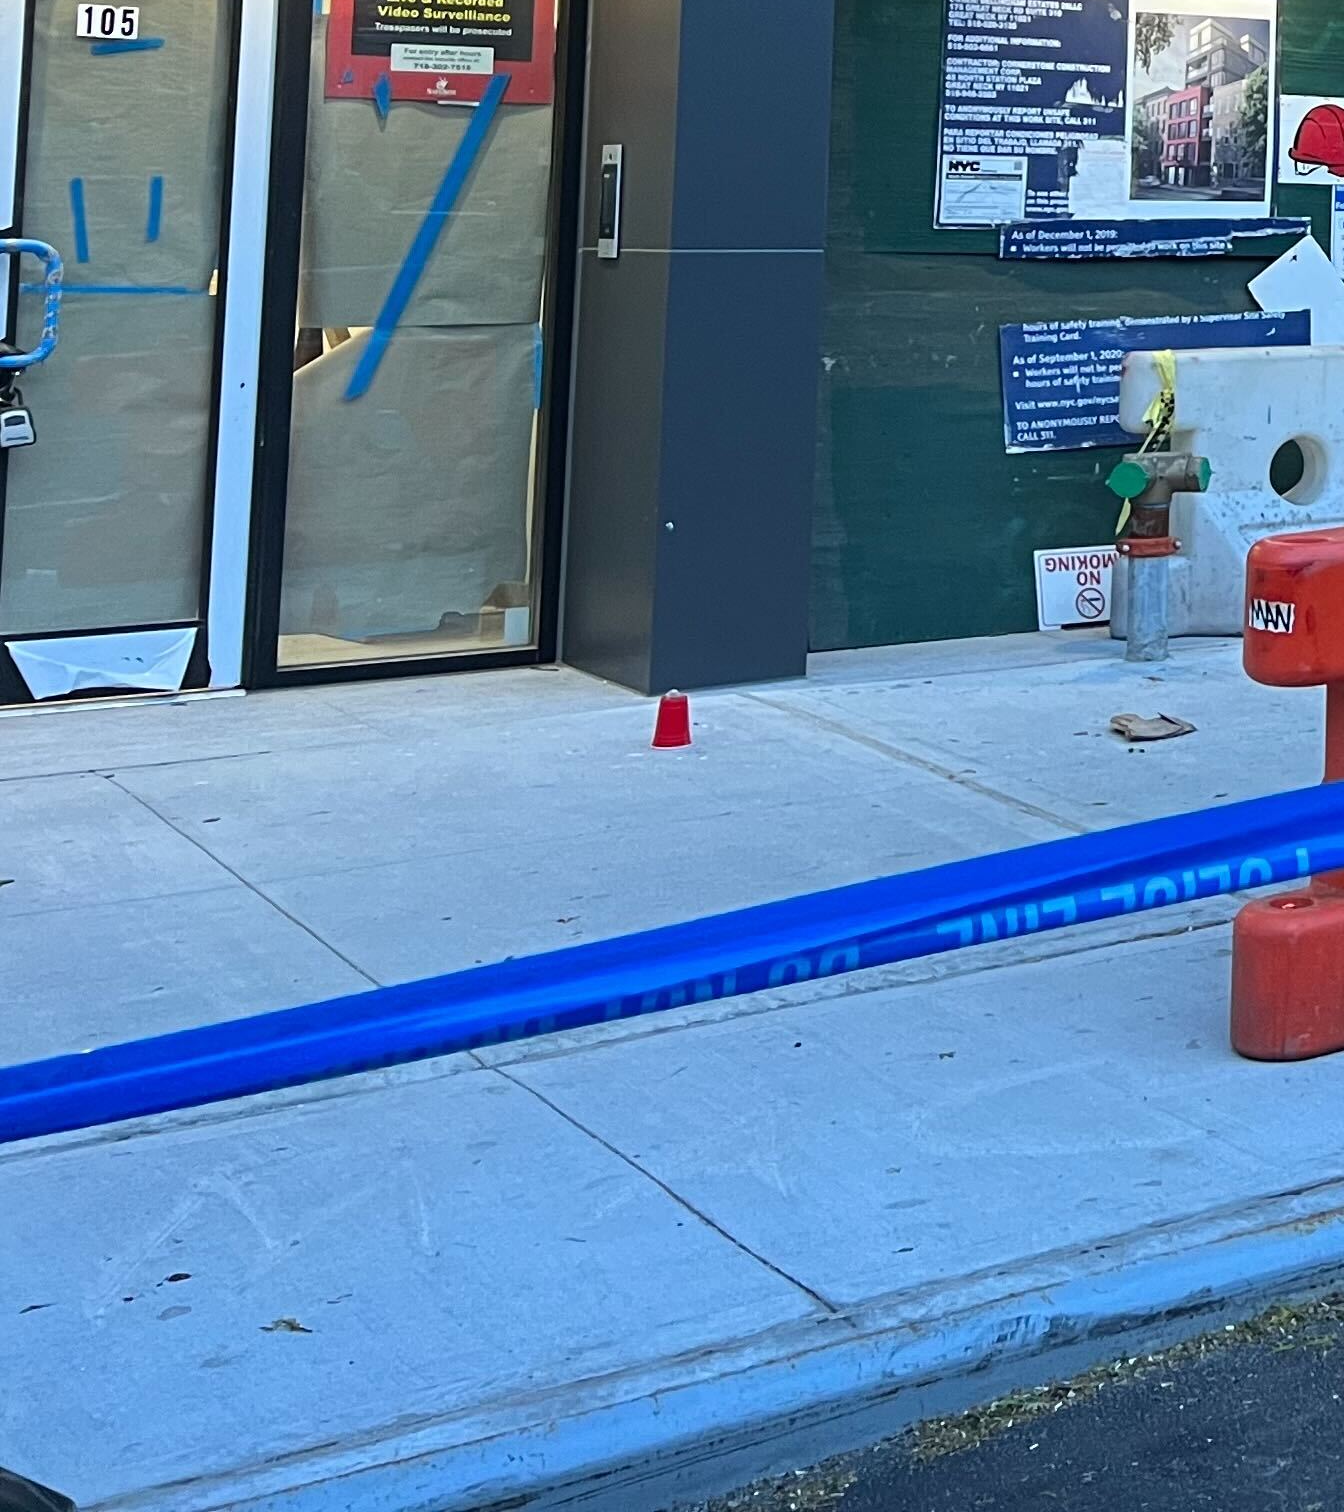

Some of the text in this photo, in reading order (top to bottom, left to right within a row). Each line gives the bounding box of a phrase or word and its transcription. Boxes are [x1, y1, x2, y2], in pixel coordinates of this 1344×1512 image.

[378, 5, 511, 22] Video Surveillance
[84, 6, 135, 36] 105
[450, 26, 460, 34] be
[949, 160, 980, 171] NYC
[1011, 230, 1023, 239] As
[1026, 230, 1036, 239] of
[1038, 230, 1084, 239] December
[1095, 230, 1118, 239] 2019:
[1023, 244, 1059, 253] Workers
[1013, 356, 1024, 365] As
[1027, 354, 1037, 364] of
[1039, 352, 1088, 364] September
[1025, 367, 1060, 376] Workers
[1080, 365, 1094, 373] not
[1025, 378, 1050, 387] hours
[1015, 401, 1036, 410] Visit
[1017, 421, 1029, 430] TO
[1031, 416, 1097, 429] ANONYMOUSLY
[1045, 553, 1121, 573] MOKING
[1077, 570, 1101, 586] NO
[1252, 599, 1292, 632] MAN
